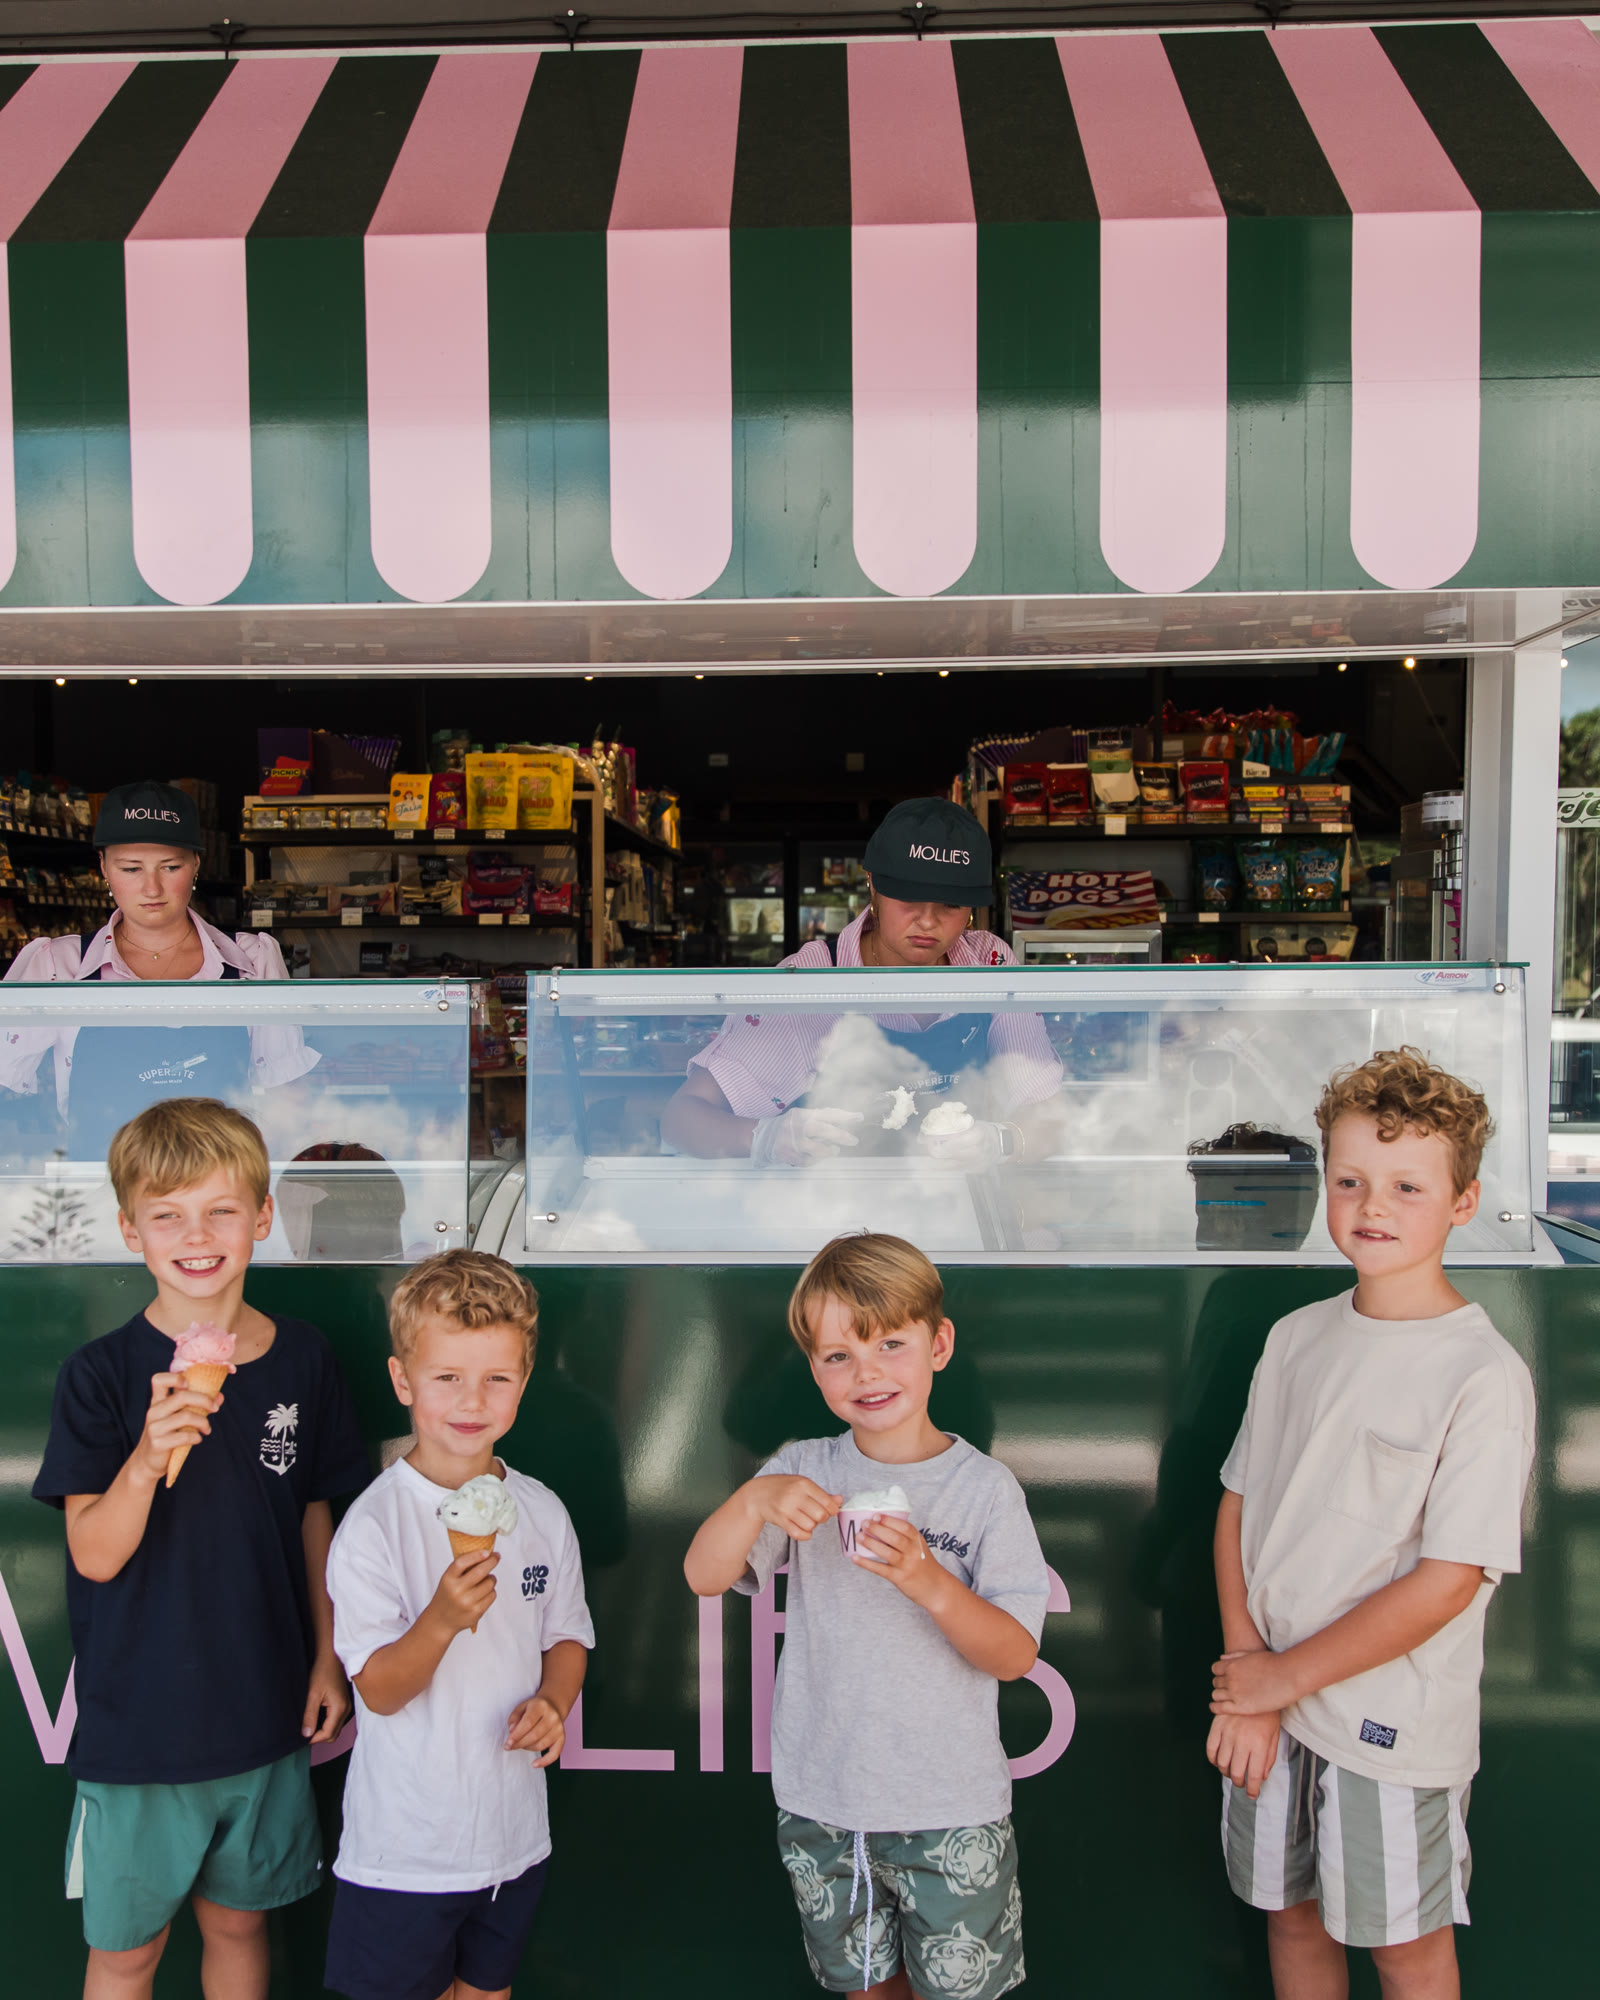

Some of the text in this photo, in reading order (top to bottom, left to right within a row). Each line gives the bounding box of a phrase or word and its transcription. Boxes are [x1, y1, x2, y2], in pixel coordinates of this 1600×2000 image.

[271, 769, 300, 777] PICNIC
[124, 808, 181, 824] MOLLIE'S
[909, 843, 970, 866] MOLLIE'S
[1047, 874, 1123, 888] HOT
[1028, 889, 1121, 904] DOGS
[138, 1067, 196, 1082] SUPERTE
[906, 1074, 960, 1090] SUPERETTE
